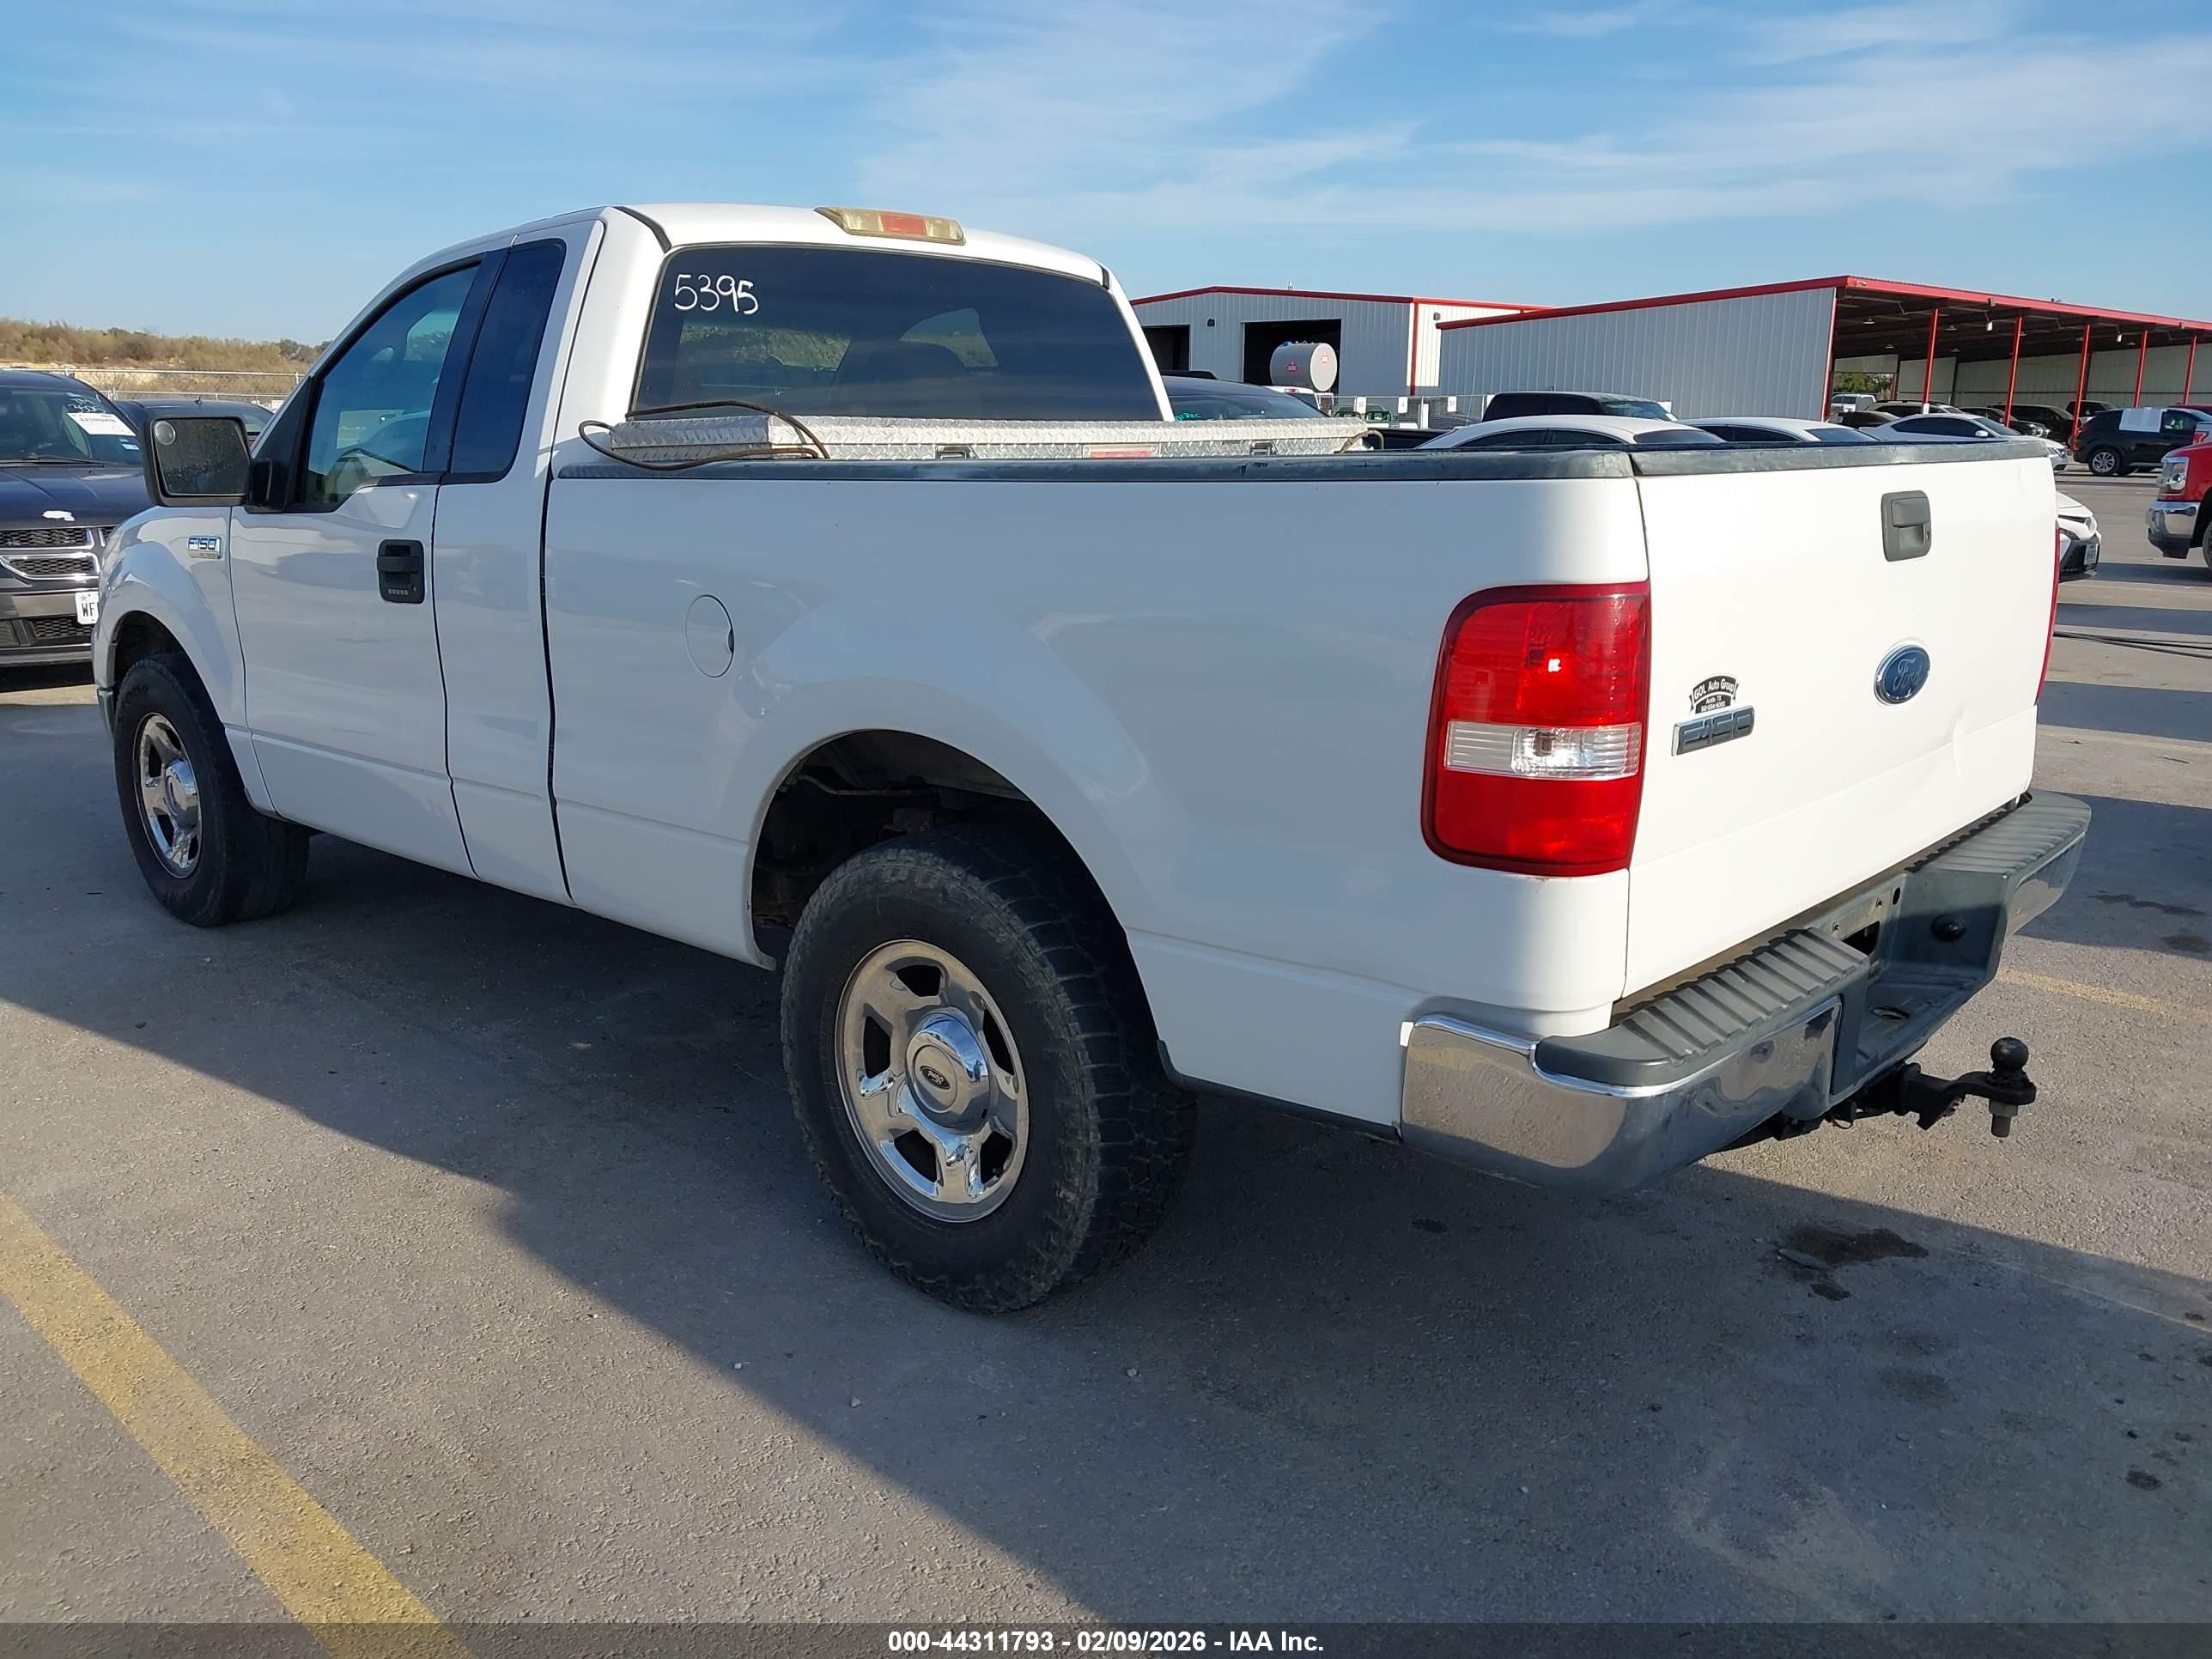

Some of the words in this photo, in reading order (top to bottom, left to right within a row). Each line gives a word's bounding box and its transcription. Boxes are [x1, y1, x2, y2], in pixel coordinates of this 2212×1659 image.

[674, 274, 759, 315] 5395
[1708, 679, 1720, 692] Auto
[1721, 678, 1735, 695] Group
[927, 1070, 945, 1085] Ford
